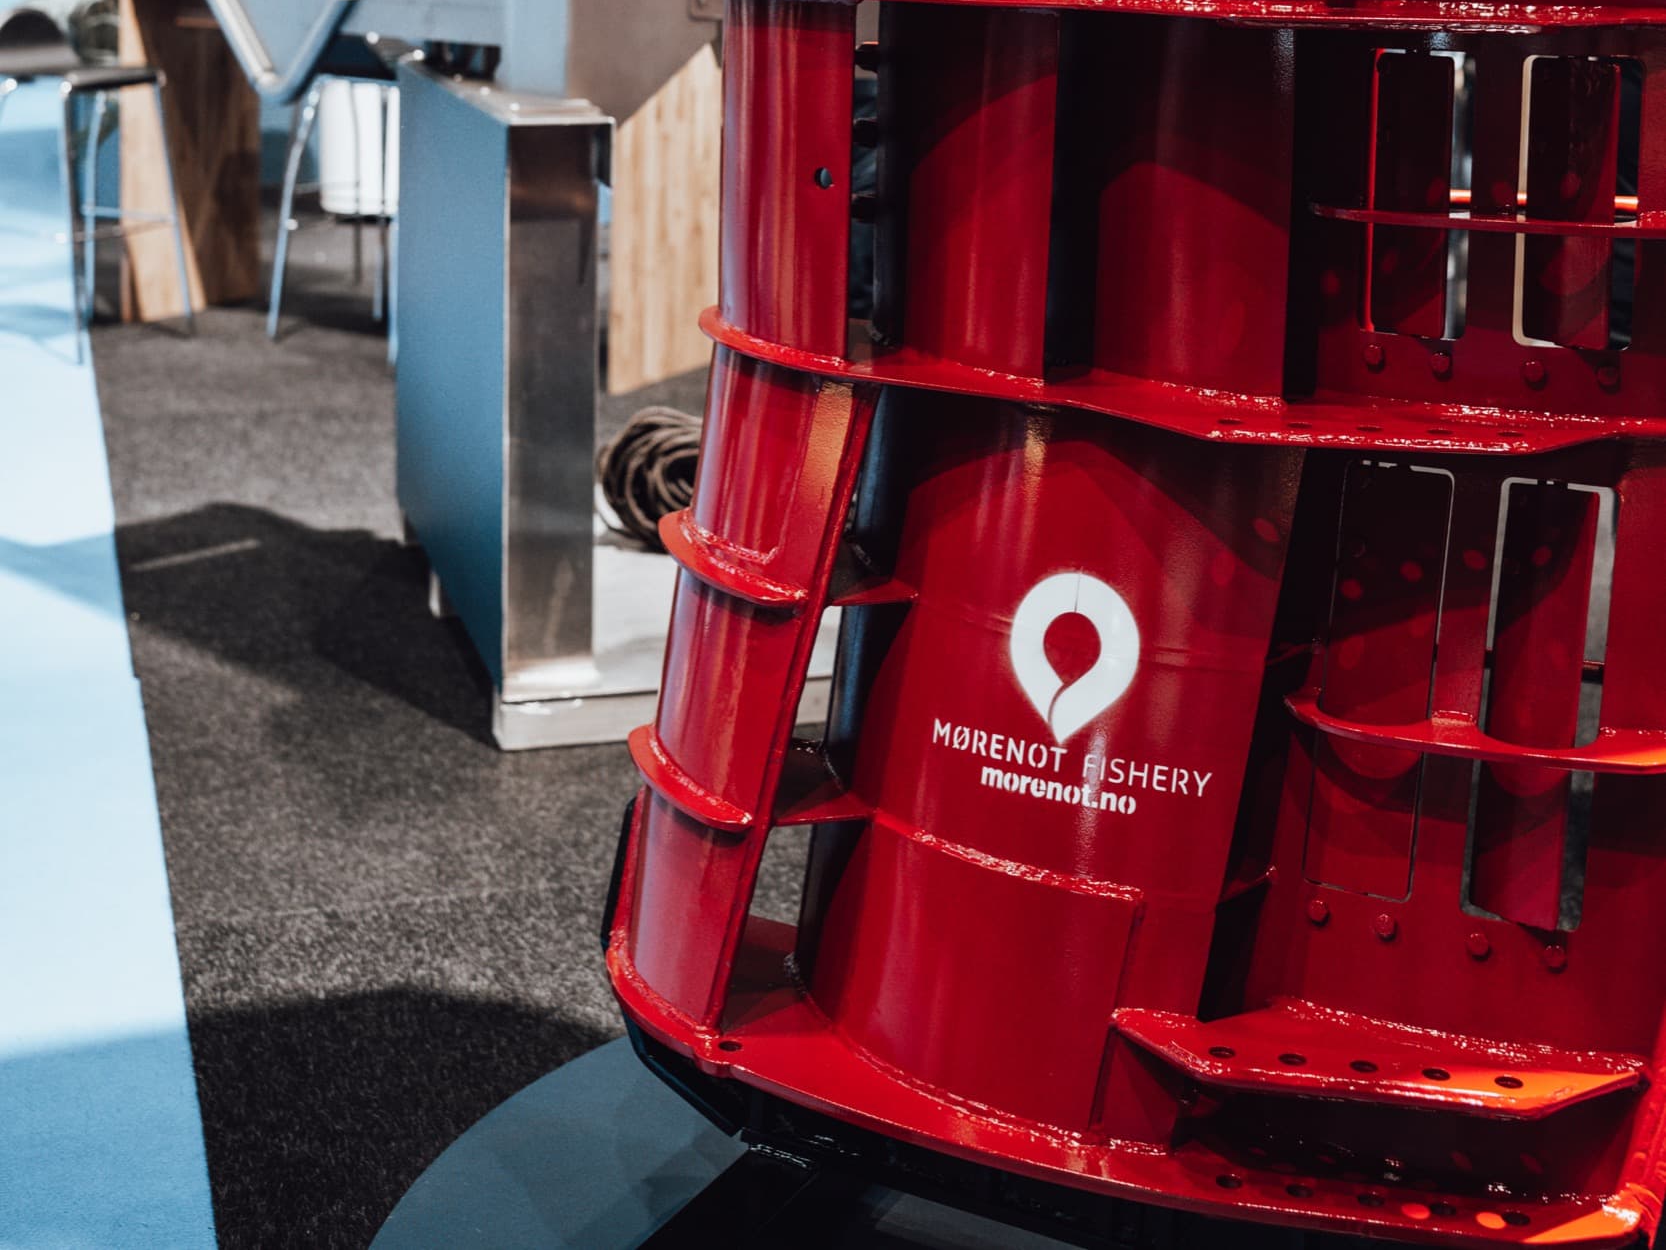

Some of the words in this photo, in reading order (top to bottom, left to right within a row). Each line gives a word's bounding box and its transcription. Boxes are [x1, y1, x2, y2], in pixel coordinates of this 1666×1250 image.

[932, 718, 1067, 772] MØRENOT
[1082, 753, 1213, 798] FISHERY
[981, 766, 1136, 815] morenot.no
